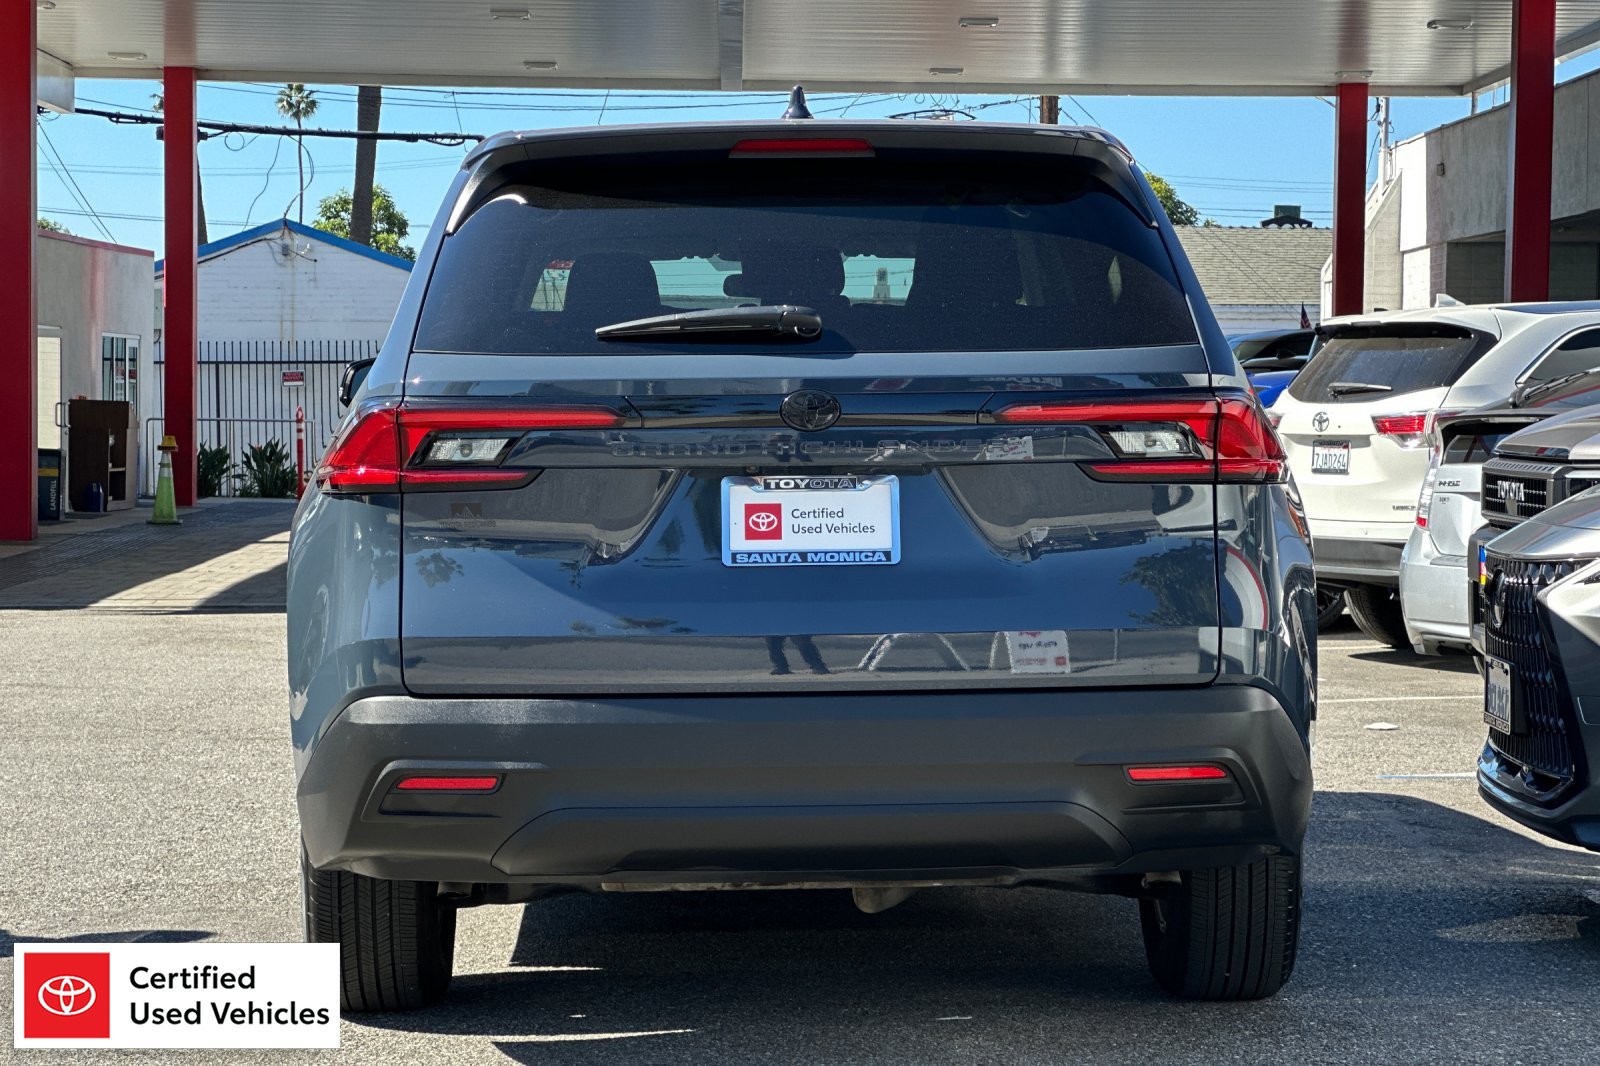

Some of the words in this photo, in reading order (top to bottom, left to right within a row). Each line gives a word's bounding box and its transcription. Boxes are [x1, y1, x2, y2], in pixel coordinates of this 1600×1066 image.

[612, 443, 746, 456] GRAND
[1315, 453, 1346, 469] 7JAD264
[766, 478, 854, 489] TOYOTA
[1497, 480, 1525, 502] TOYOTA
[791, 508, 844, 519] Certified
[792, 523, 822, 534] Used
[826, 522, 876, 534] Vehicles
[735, 552, 802, 563] SANTA
[807, 551, 887, 563] MONICA
